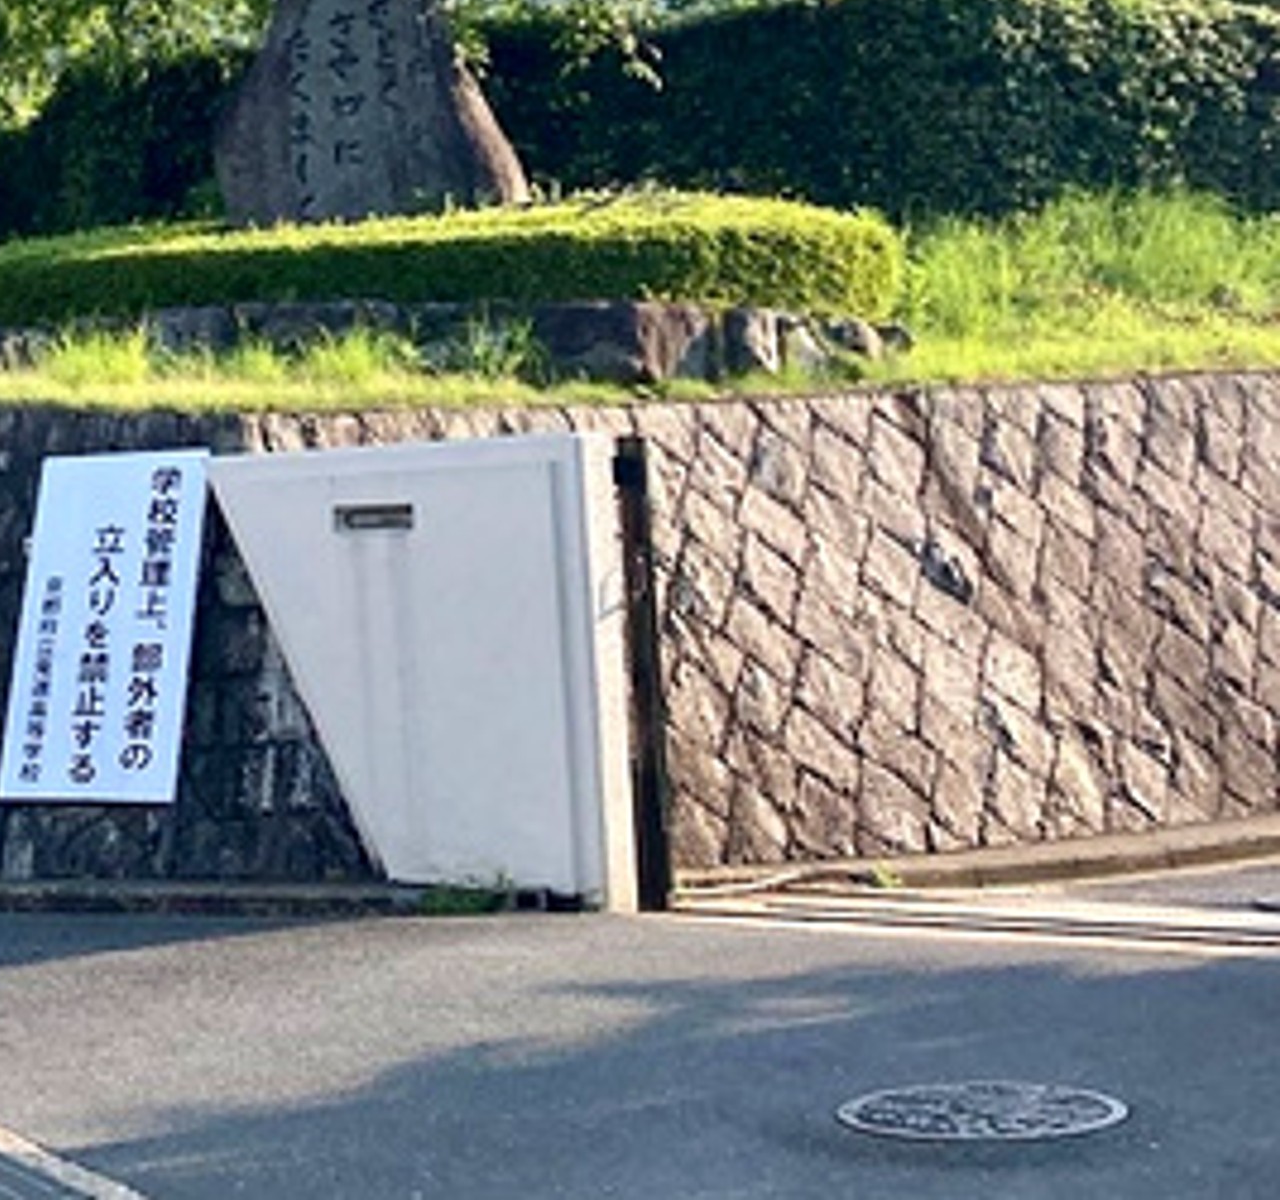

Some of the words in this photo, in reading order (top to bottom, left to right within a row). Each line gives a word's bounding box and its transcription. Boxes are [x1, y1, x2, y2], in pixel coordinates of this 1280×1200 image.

[68, 524, 125, 784] 立入りを禁止する
[118, 467, 183, 769] 学校管理上、部外者の
